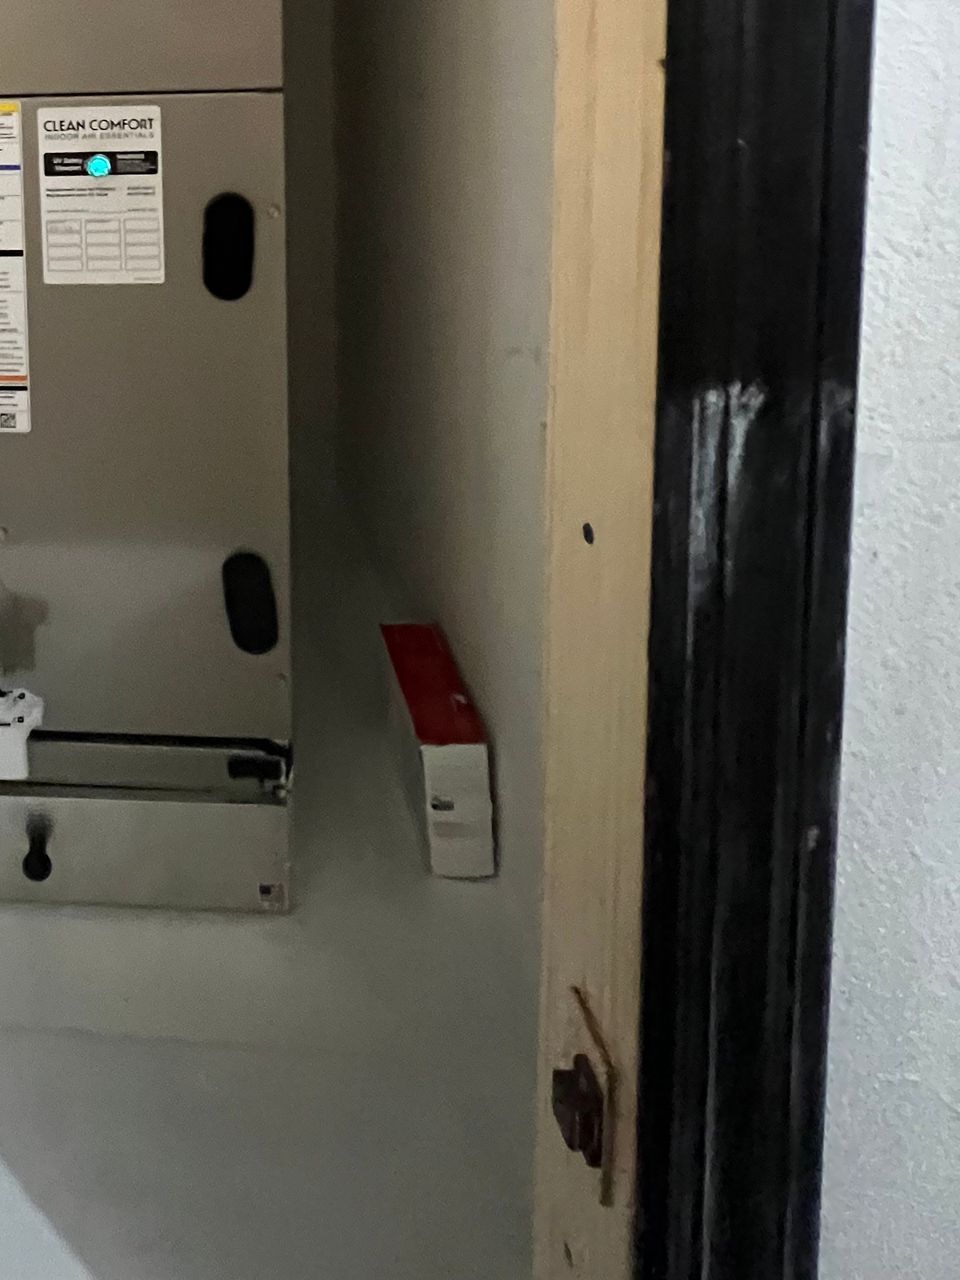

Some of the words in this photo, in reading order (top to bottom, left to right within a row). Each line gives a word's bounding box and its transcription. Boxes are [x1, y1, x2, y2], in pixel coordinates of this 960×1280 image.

[43, 120, 86, 132] CLEAN
[89, 117, 154, 131] COMFORT
[44, 133, 80, 141] INDOOR
[81, 132, 97, 140] AIR
[100, 131, 154, 139] ESSENTIALS
